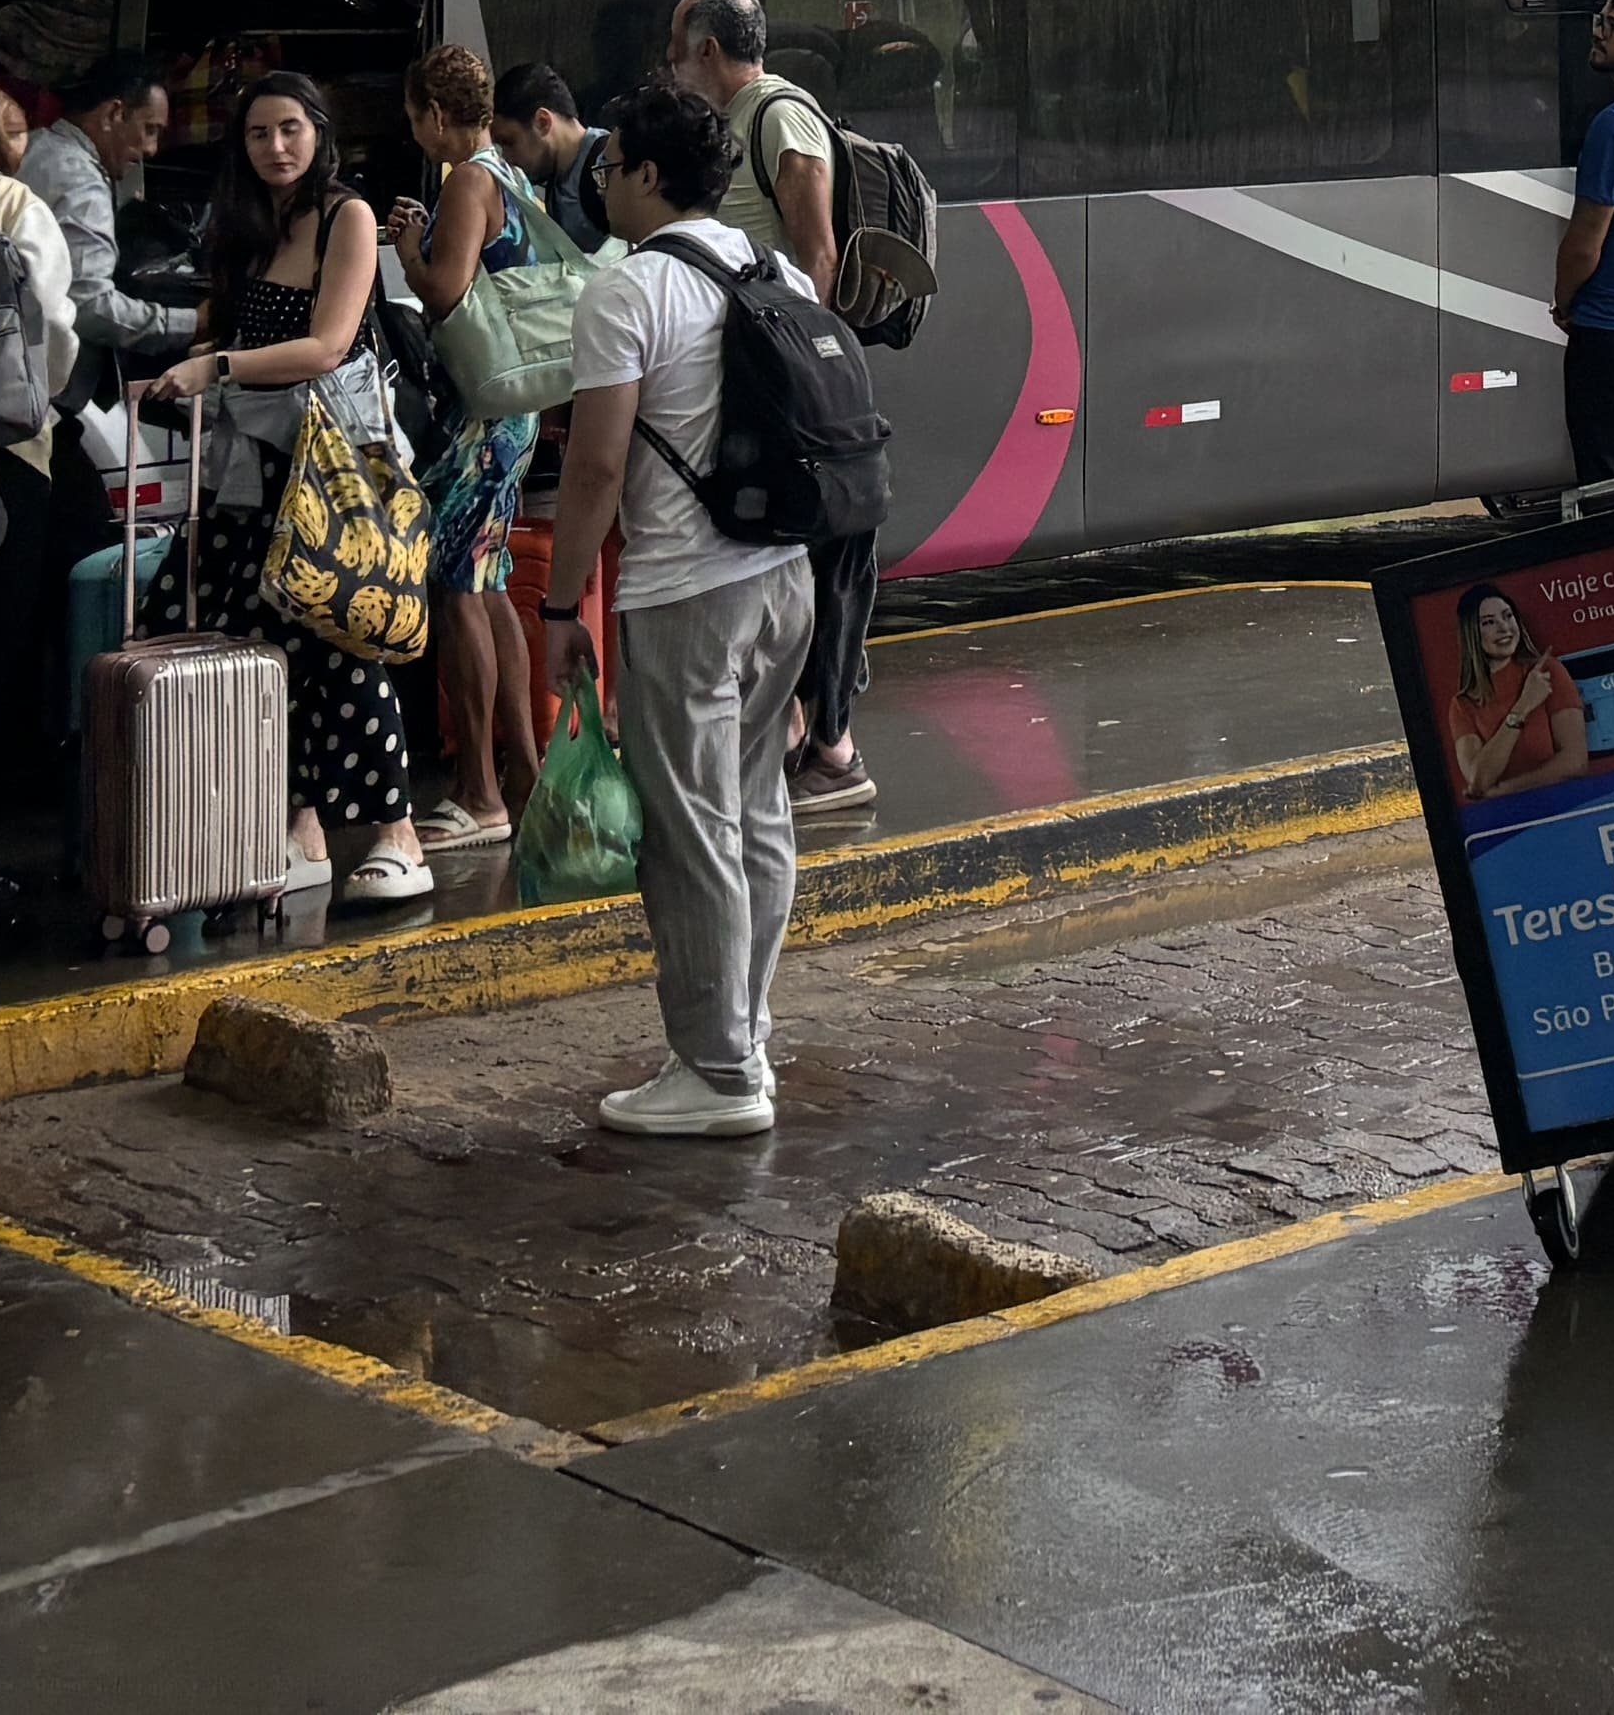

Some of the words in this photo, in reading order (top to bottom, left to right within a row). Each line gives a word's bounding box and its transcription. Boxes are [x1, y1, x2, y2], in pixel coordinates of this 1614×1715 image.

[1539, 574, 1600, 604] Viaje
[1572, 608, 1586, 625] O
[1532, 1003, 1591, 1036] São
